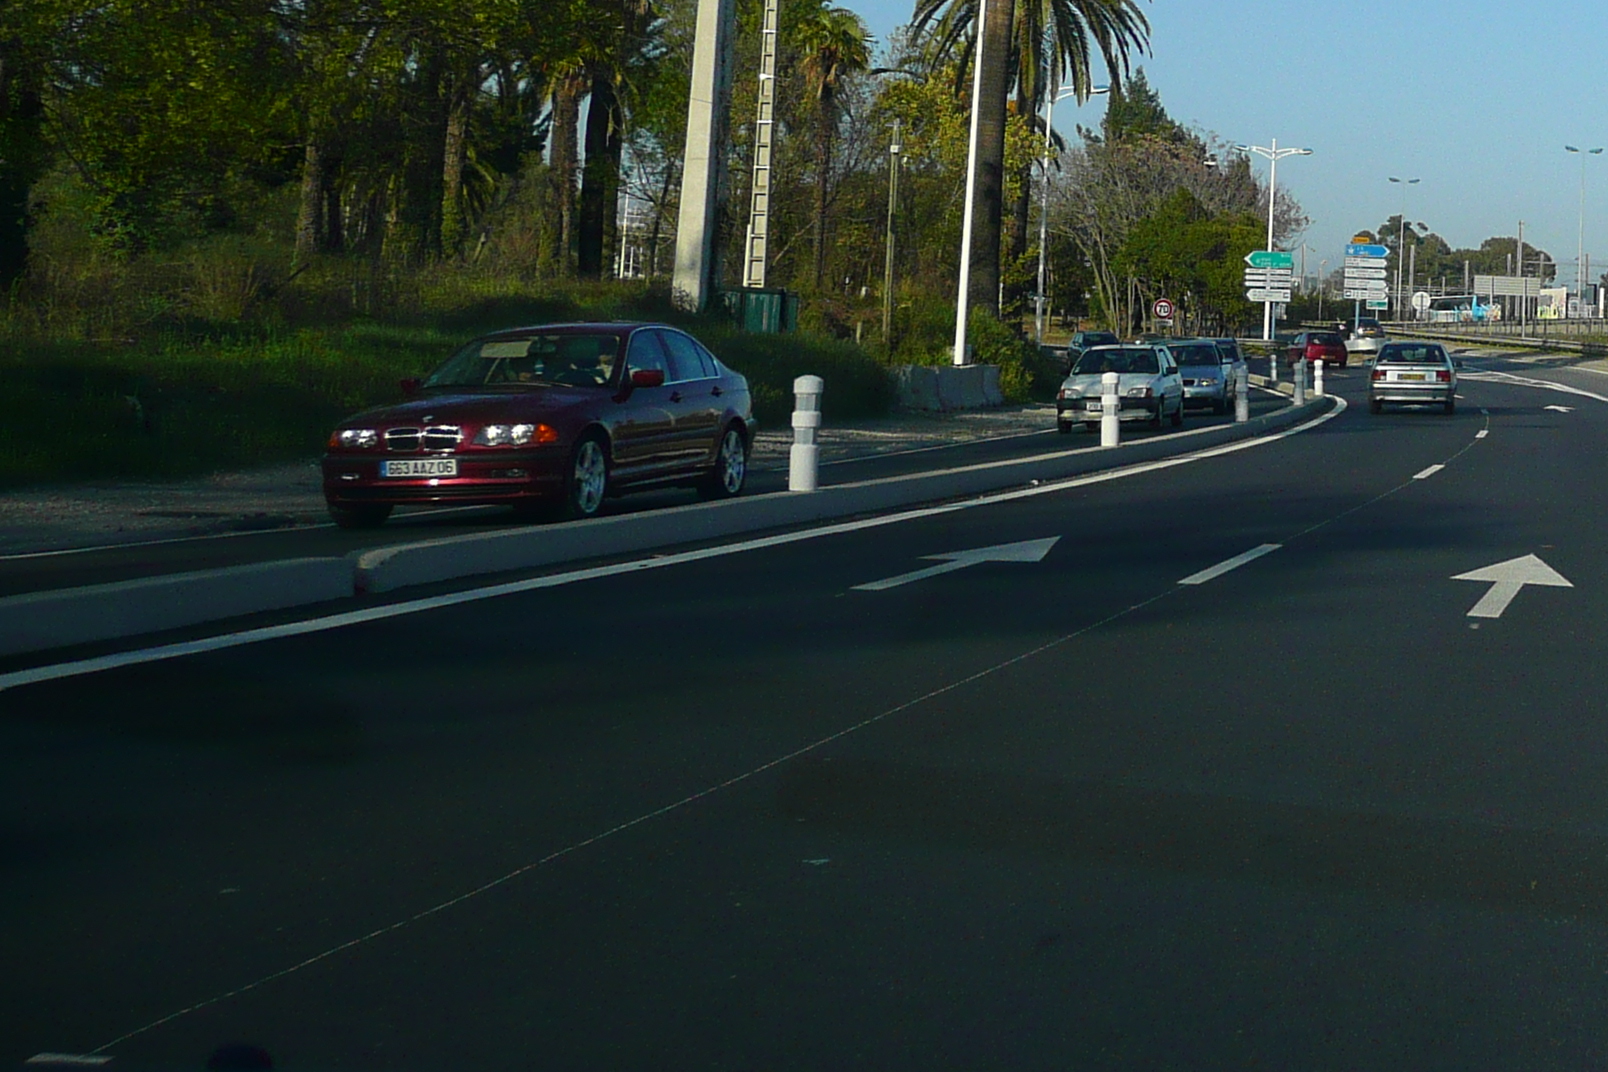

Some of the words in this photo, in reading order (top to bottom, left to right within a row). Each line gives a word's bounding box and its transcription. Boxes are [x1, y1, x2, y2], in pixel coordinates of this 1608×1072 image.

[1158, 304, 1169, 313] 70
[388, 462, 410, 475] 663
[413, 462, 436, 474] AAZ
[437, 461, 453, 473] 06
